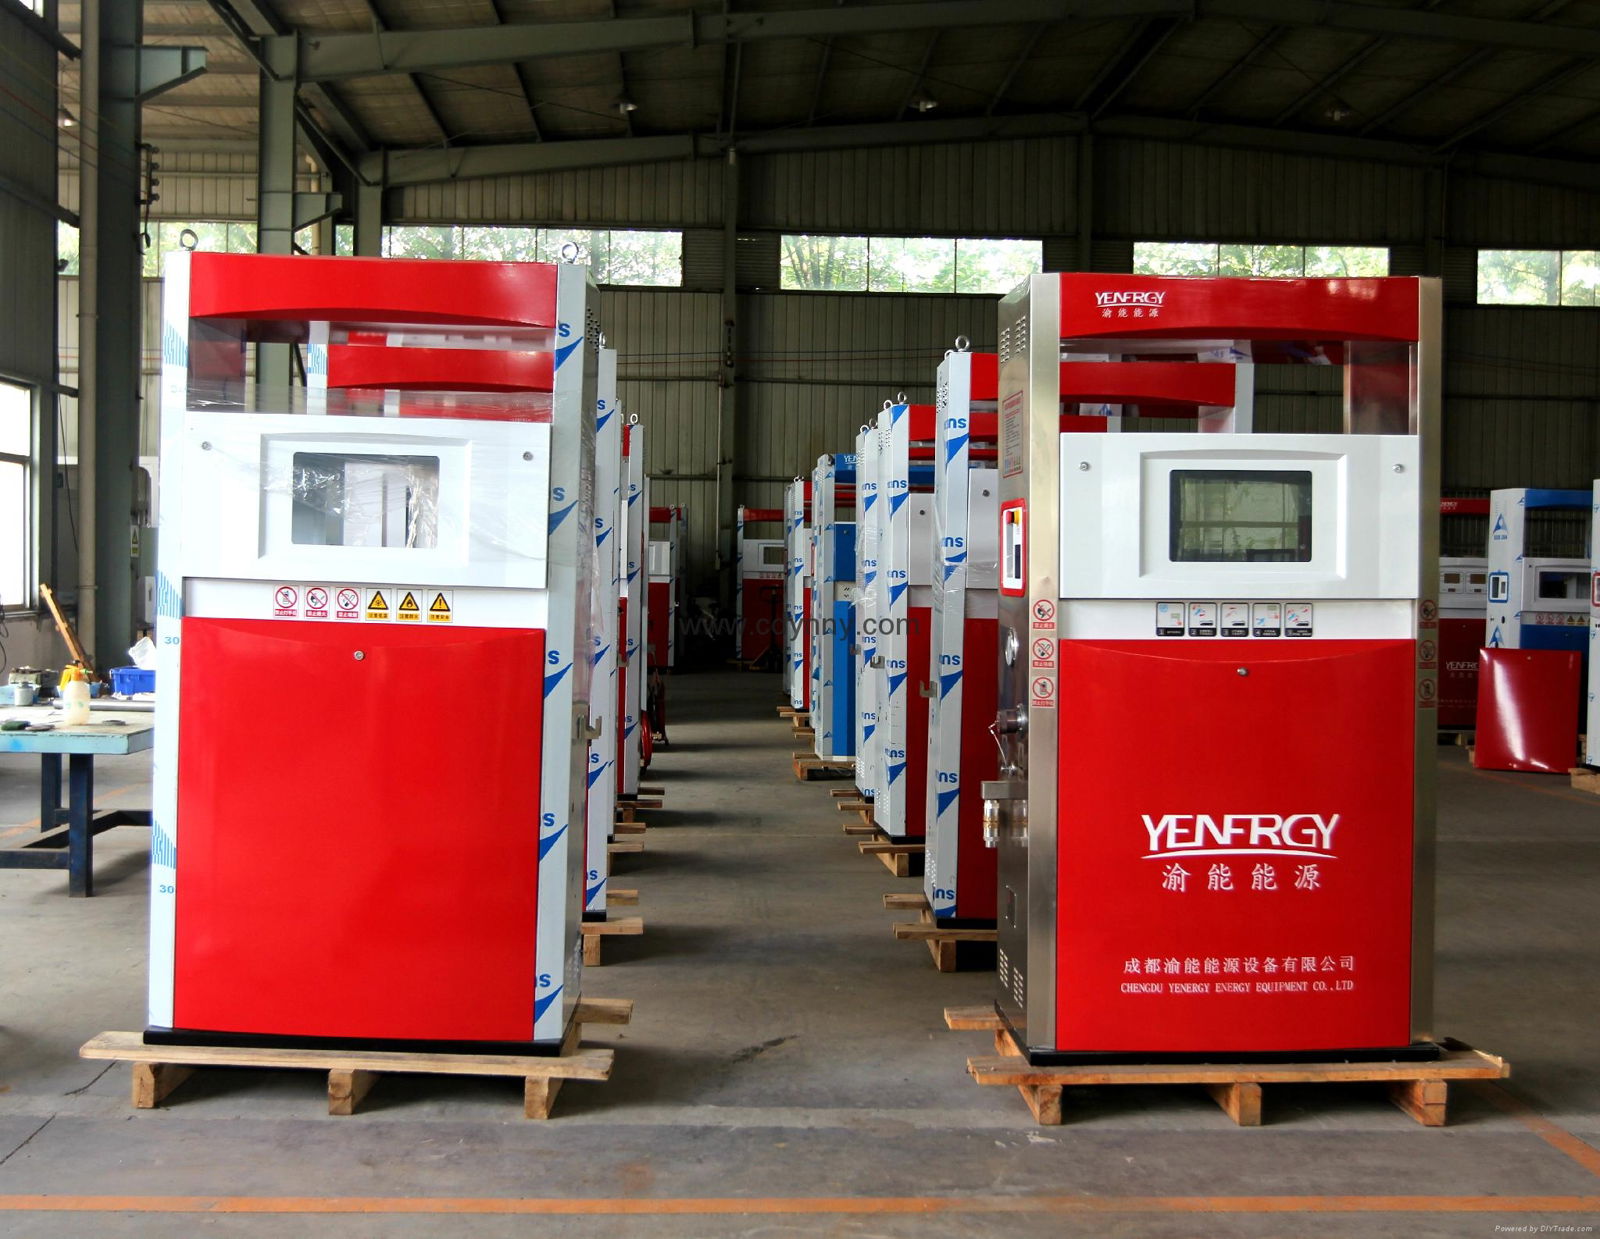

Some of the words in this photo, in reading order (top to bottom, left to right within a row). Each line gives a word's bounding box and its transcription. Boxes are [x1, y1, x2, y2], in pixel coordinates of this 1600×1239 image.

[943, 536, 965, 548] ns
[540, 812, 555, 827] s
[1161, 862, 1322, 892] 渝能能源
[535, 973, 551, 988] s
[1120, 982, 1164, 993] CHENGDU
[1168, 982, 1210, 993] YENERGY
[1215, 981, 1251, 993] ENERGY
[1255, 981, 1309, 993] EQUIPMENT
